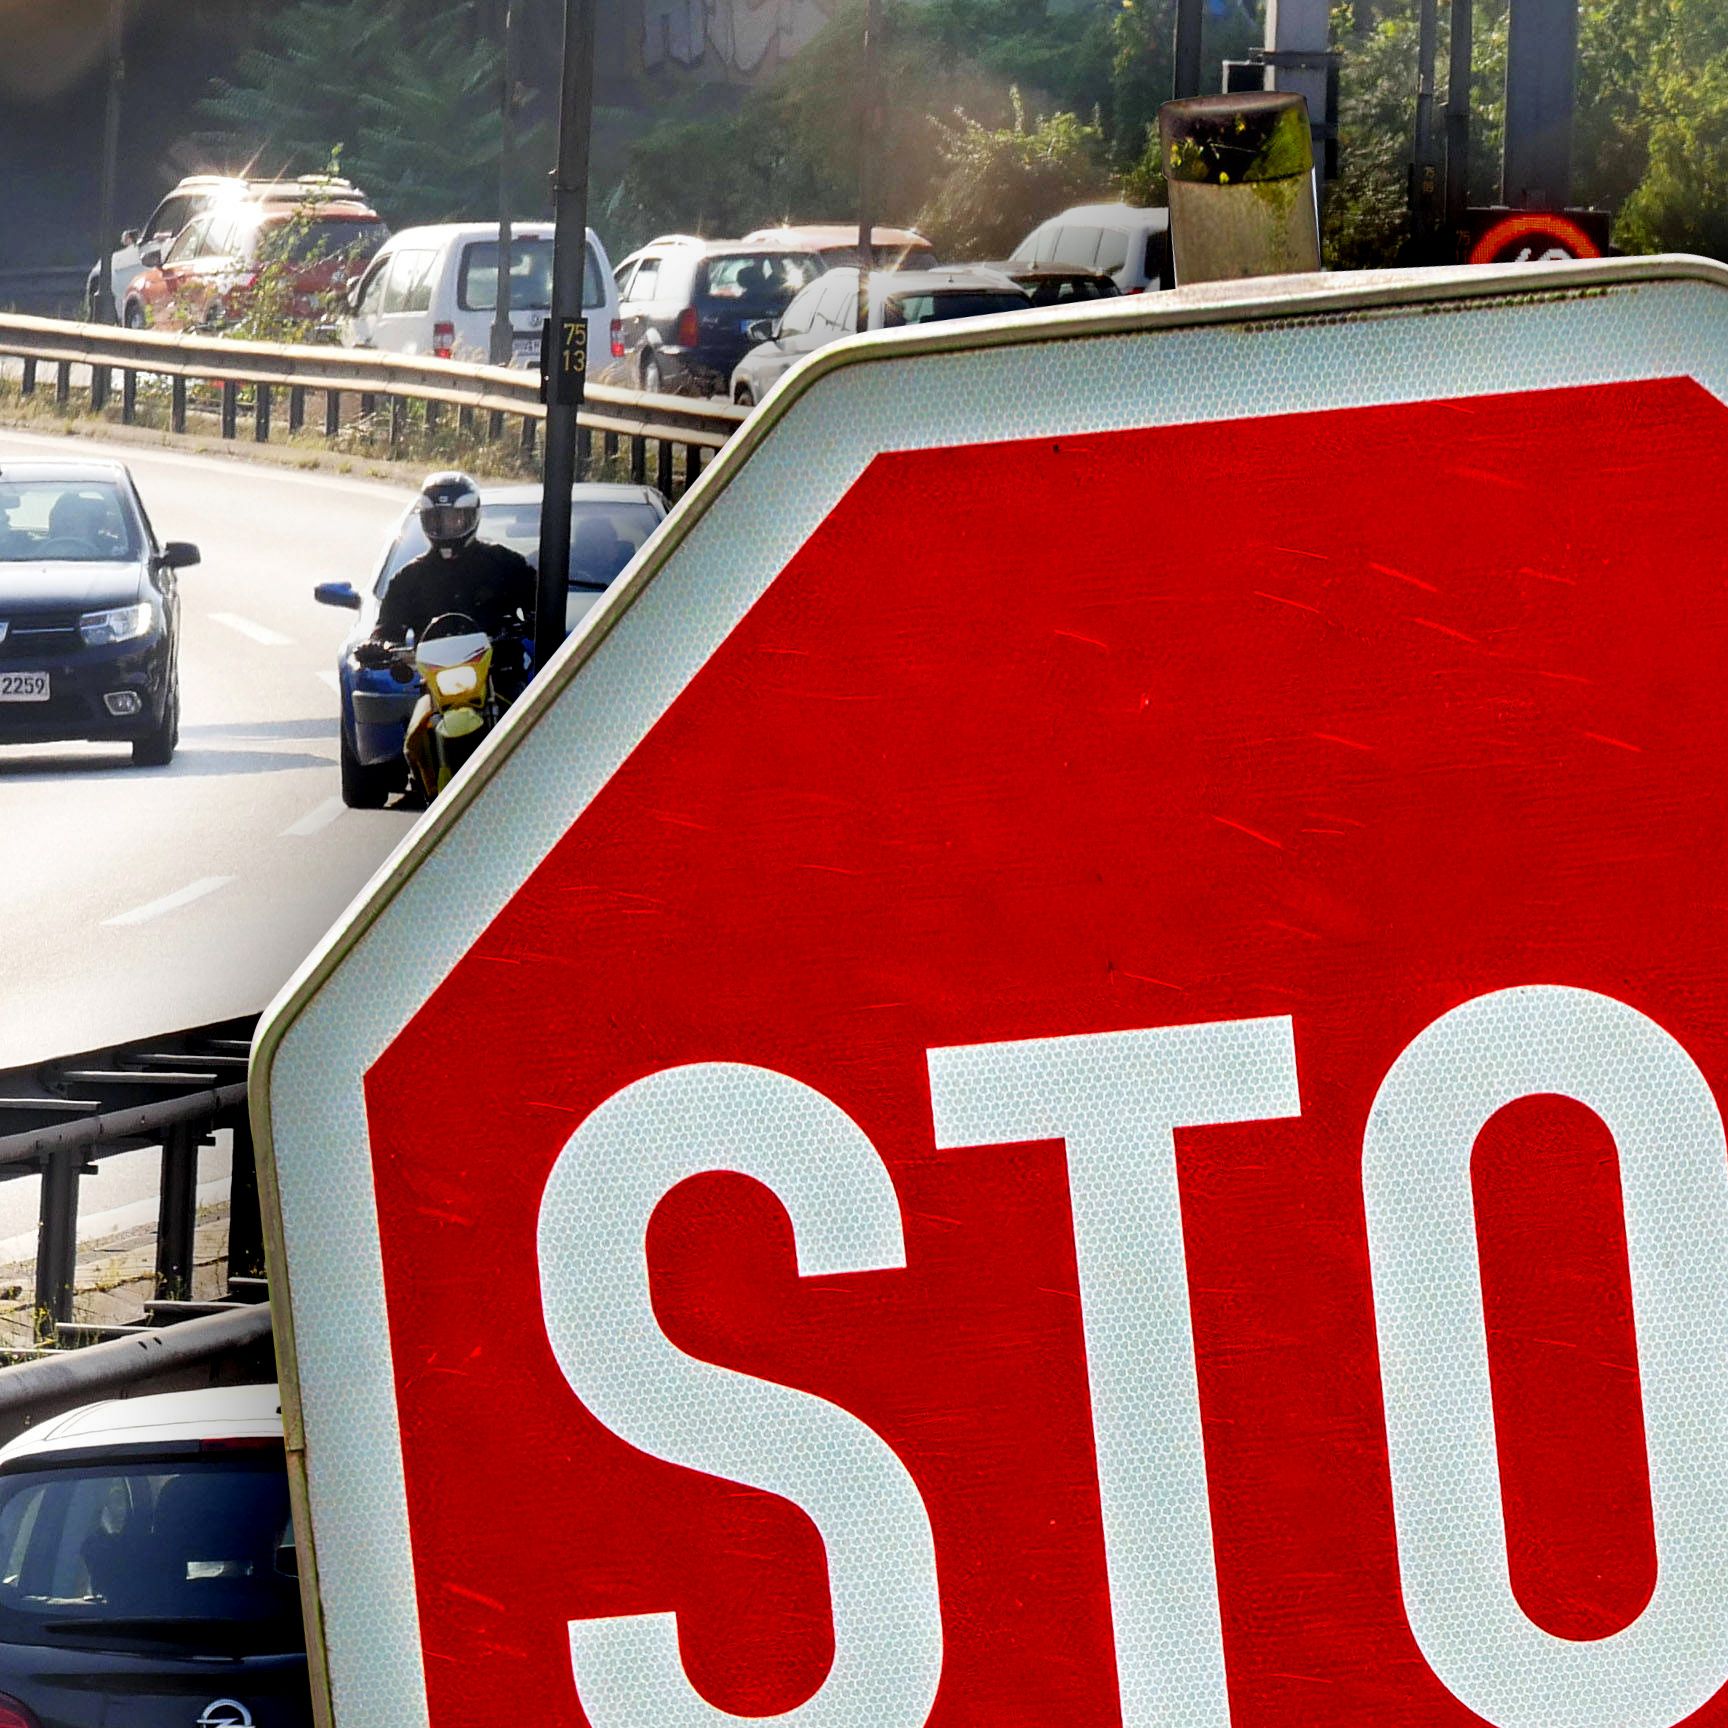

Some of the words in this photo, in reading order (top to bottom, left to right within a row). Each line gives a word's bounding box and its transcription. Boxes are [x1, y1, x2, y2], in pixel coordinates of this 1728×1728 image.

[564, 323, 586, 346] 75
[563, 350, 586, 372] 13
[2, 677, 45, 694] 2259
